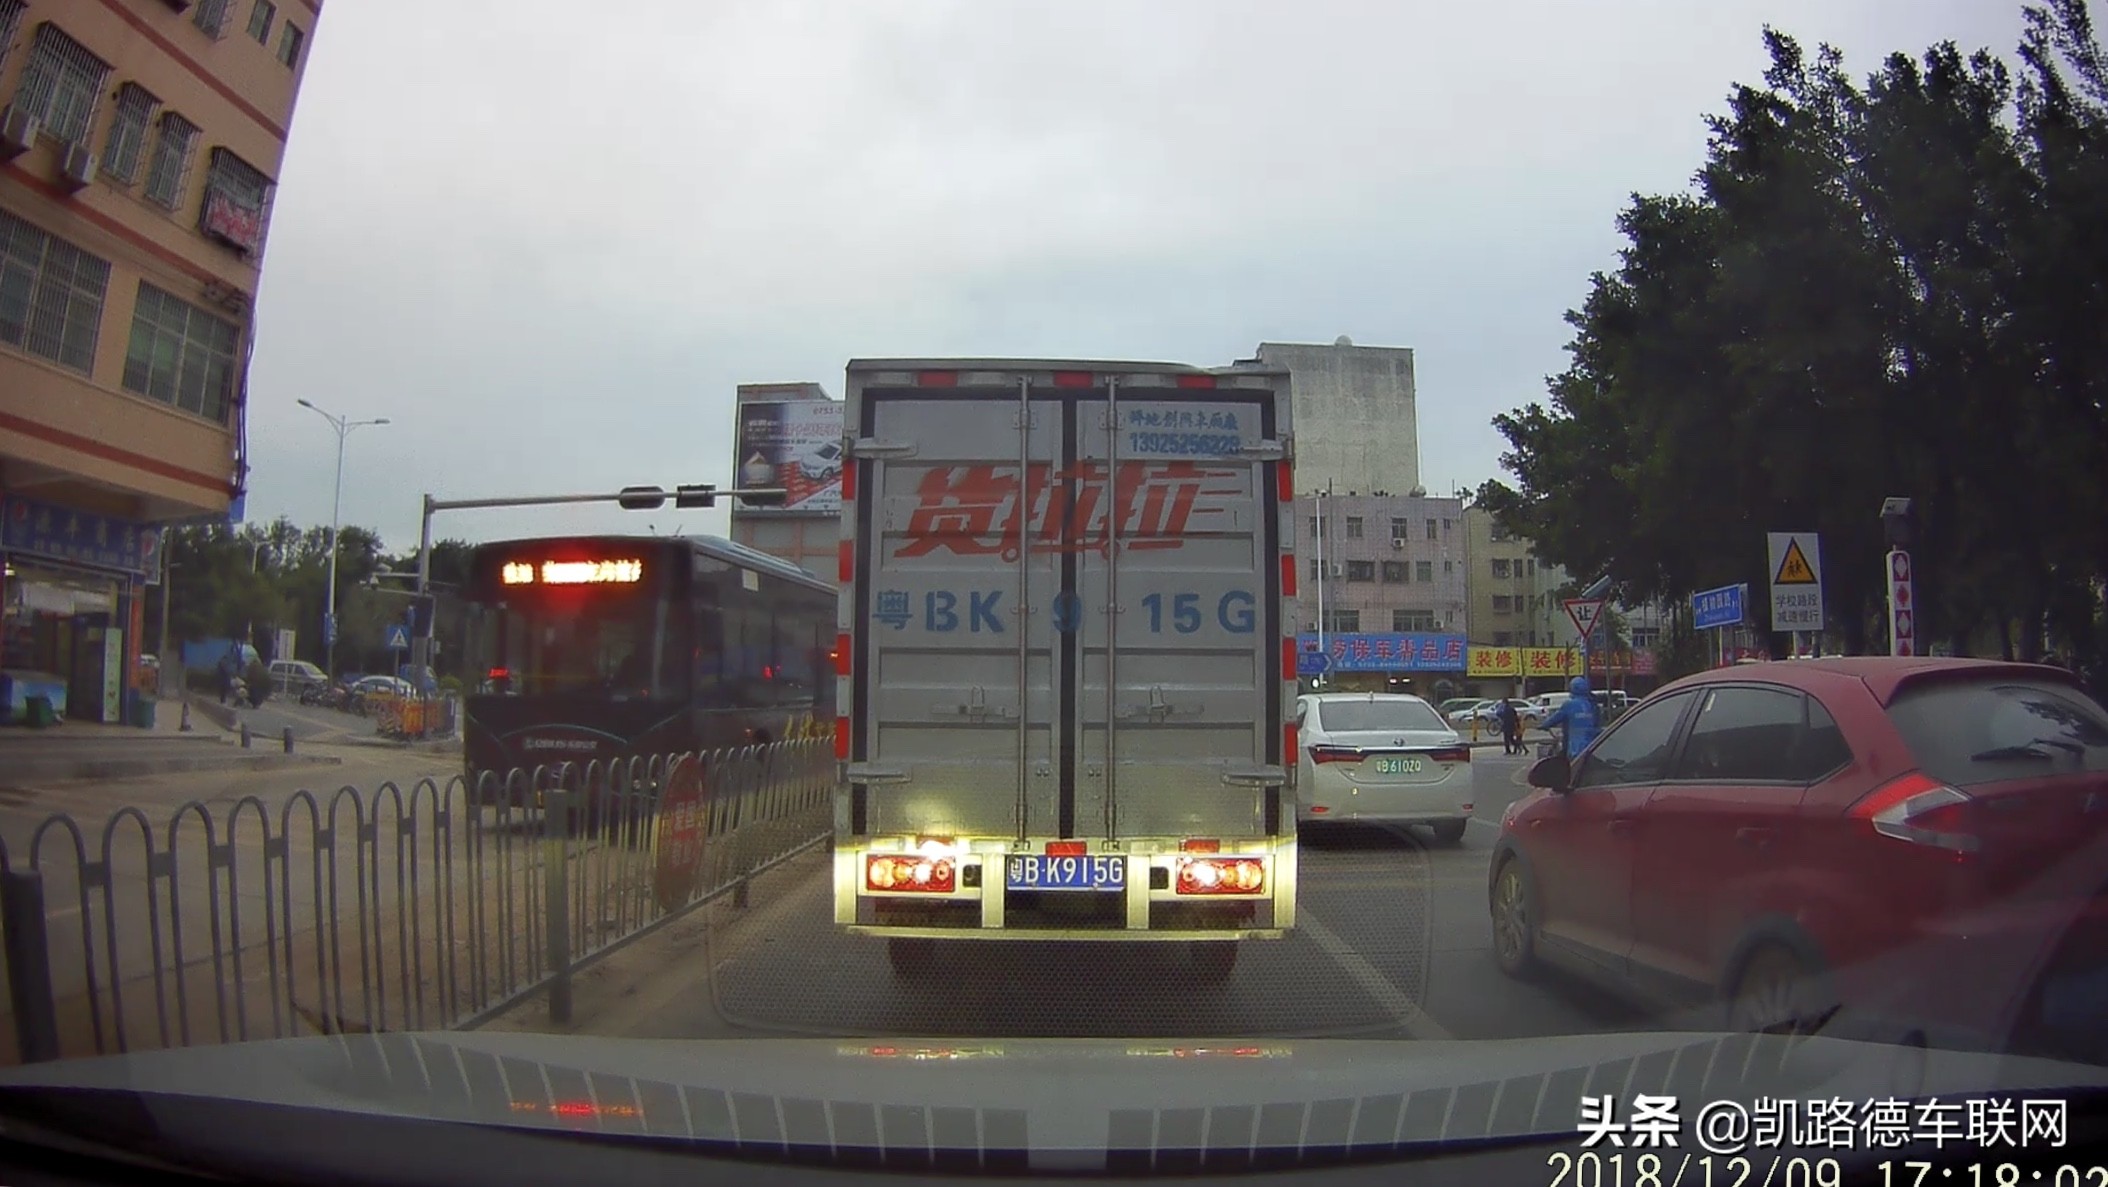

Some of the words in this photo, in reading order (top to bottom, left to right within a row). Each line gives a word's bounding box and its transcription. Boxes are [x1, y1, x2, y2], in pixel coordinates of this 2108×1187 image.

[893, 460, 1207, 562] 货拉拉
[1775, 593, 1818, 608] 学校路段
[1575, 606, 1592, 622] 让
[1777, 610, 1820, 623] 减速慢行
[1475, 650, 1513, 669] 装修
[1530, 649, 1576, 670] 装修
